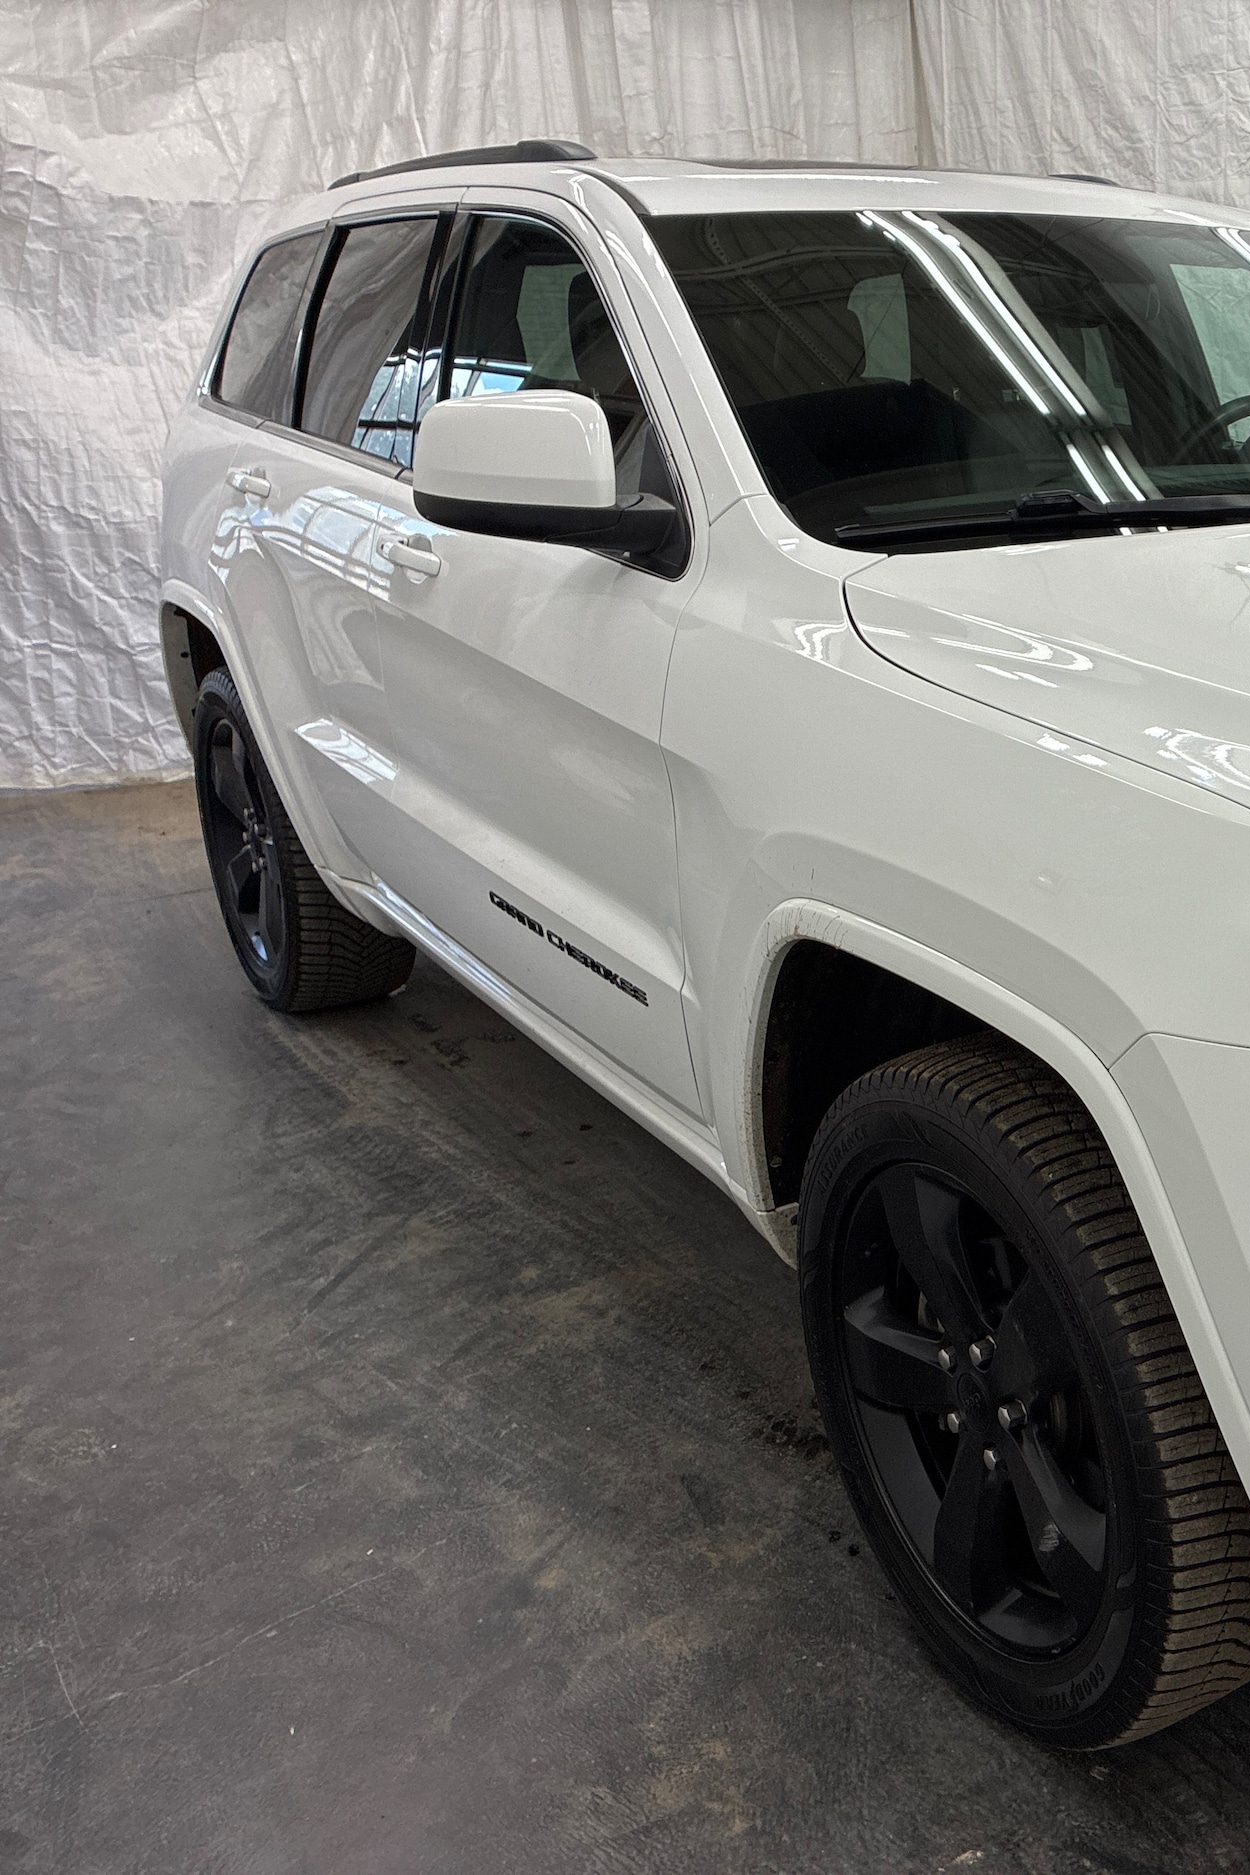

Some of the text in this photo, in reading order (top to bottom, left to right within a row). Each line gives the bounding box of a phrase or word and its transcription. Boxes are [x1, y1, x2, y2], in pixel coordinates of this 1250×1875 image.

[489, 890, 649, 1007] GRAND CHEROKEE
[1034, 1662, 1105, 1712] GOODYEAR
